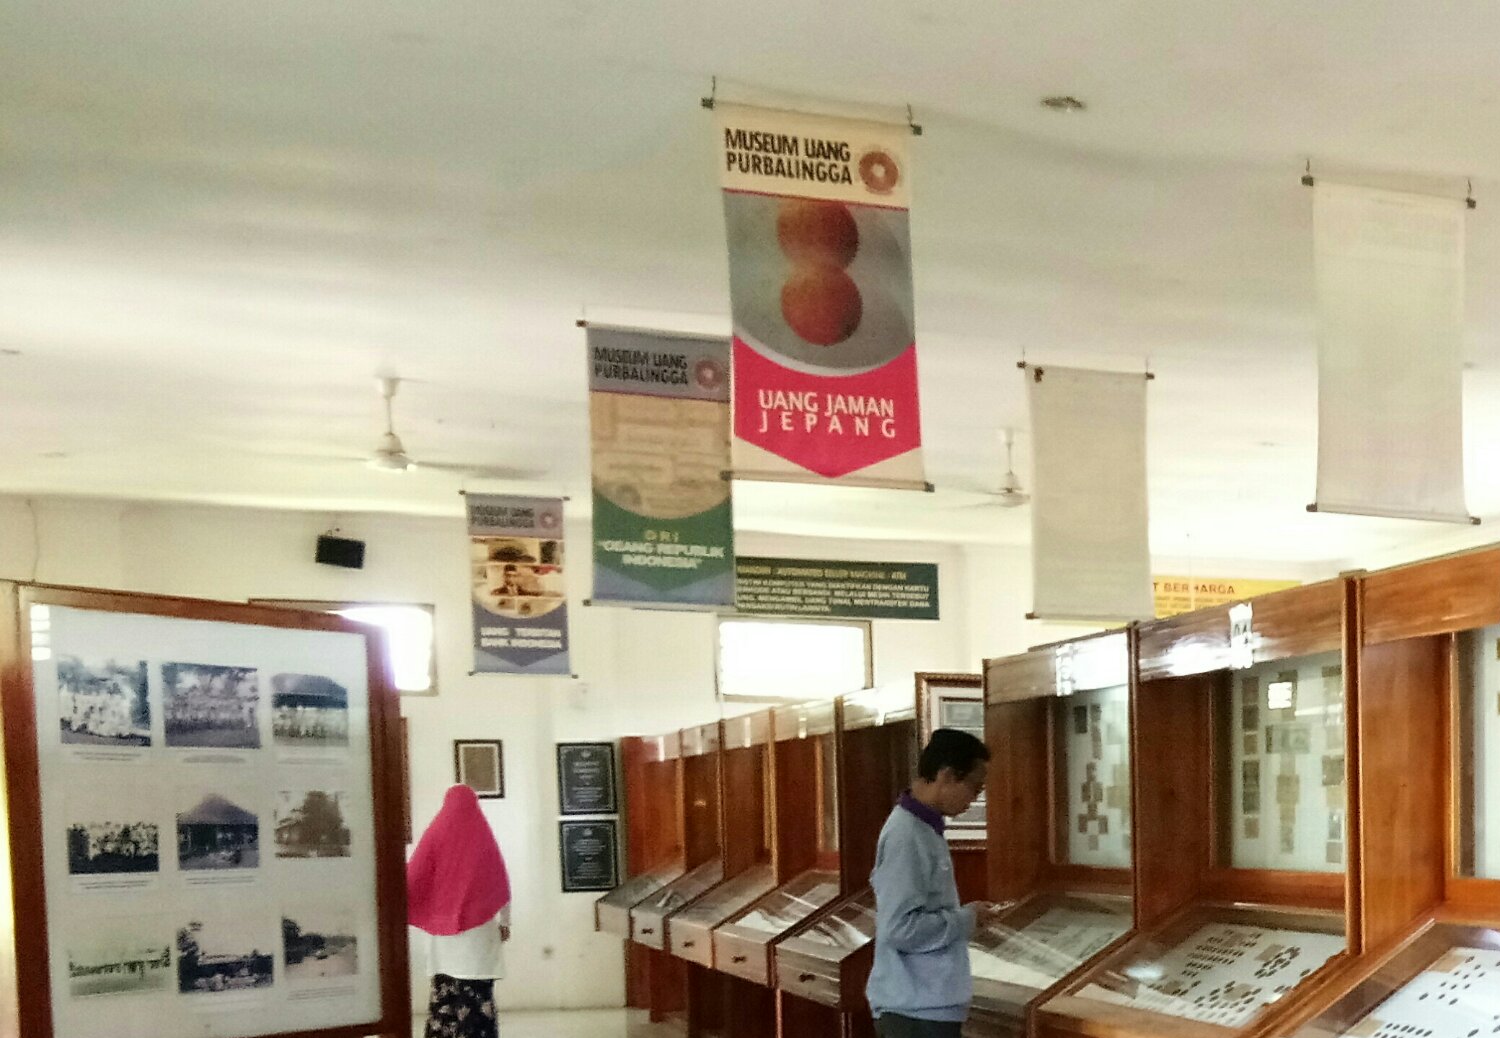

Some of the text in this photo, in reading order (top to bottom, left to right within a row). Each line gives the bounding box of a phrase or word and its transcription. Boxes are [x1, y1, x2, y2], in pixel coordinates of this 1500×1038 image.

[725, 128, 851, 162] MUSEUM UANG
[727, 151, 852, 185] PURBALINGGA
[594, 346, 688, 369] MUSEUM UANG
[595, 363, 689, 385] PURBALINGGA
[758, 389, 895, 418] UANG JAMAN
